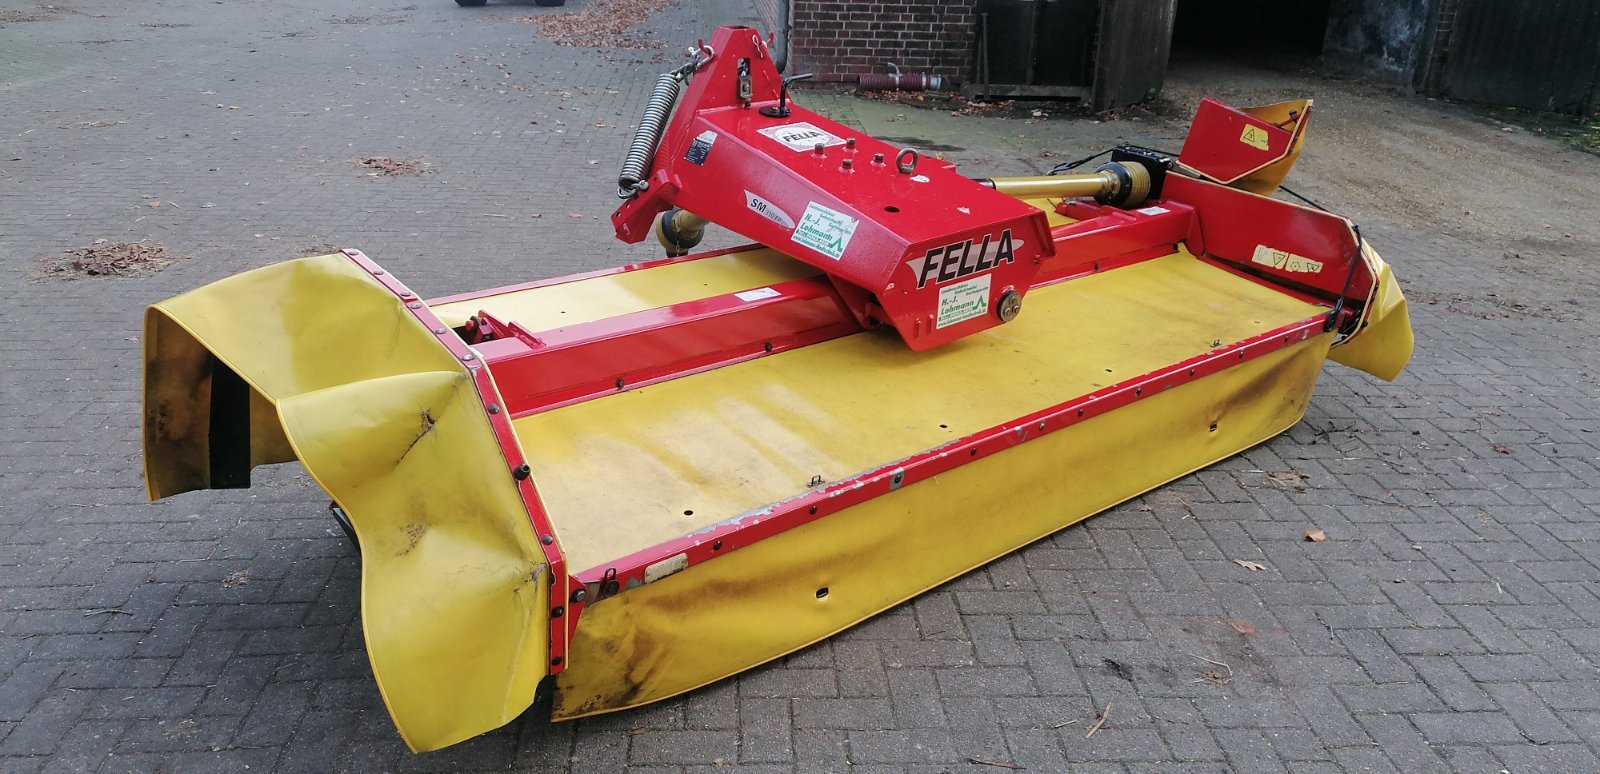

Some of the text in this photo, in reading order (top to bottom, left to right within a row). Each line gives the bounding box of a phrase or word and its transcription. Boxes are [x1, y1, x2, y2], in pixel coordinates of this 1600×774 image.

[782, 131, 821, 143] FELLA
[750, 198, 767, 213] SM
[804, 213, 821, 226] H.-J.
[800, 222, 833, 241] Lohmann
[917, 229, 1014, 289] FELLA
[941, 295, 958, 306] H.-J.
[941, 300, 975, 315] Lohmann
